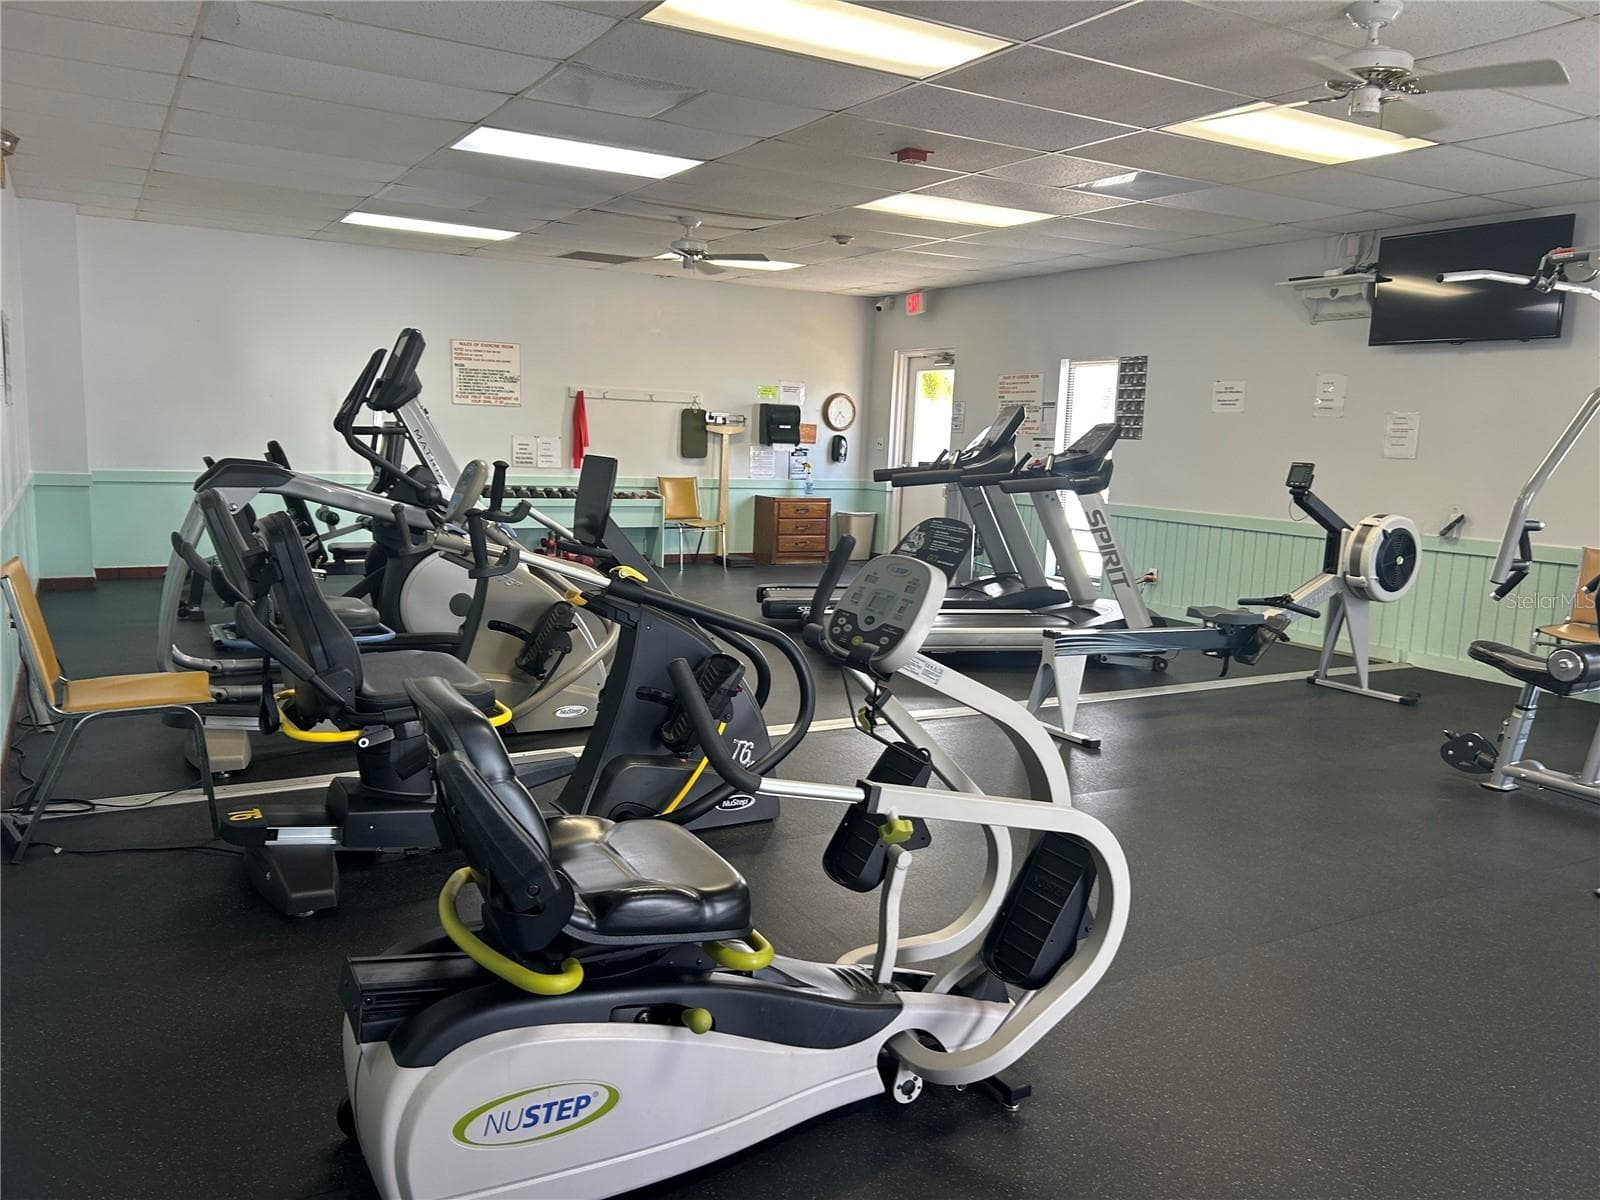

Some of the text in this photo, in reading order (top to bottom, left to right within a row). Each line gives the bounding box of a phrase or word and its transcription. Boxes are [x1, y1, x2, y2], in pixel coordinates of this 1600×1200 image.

[1085, 509, 1131, 588] SPIRIT
[722, 798, 749, 808] NuStep
[483, 1094, 592, 1137] NUSTEP
